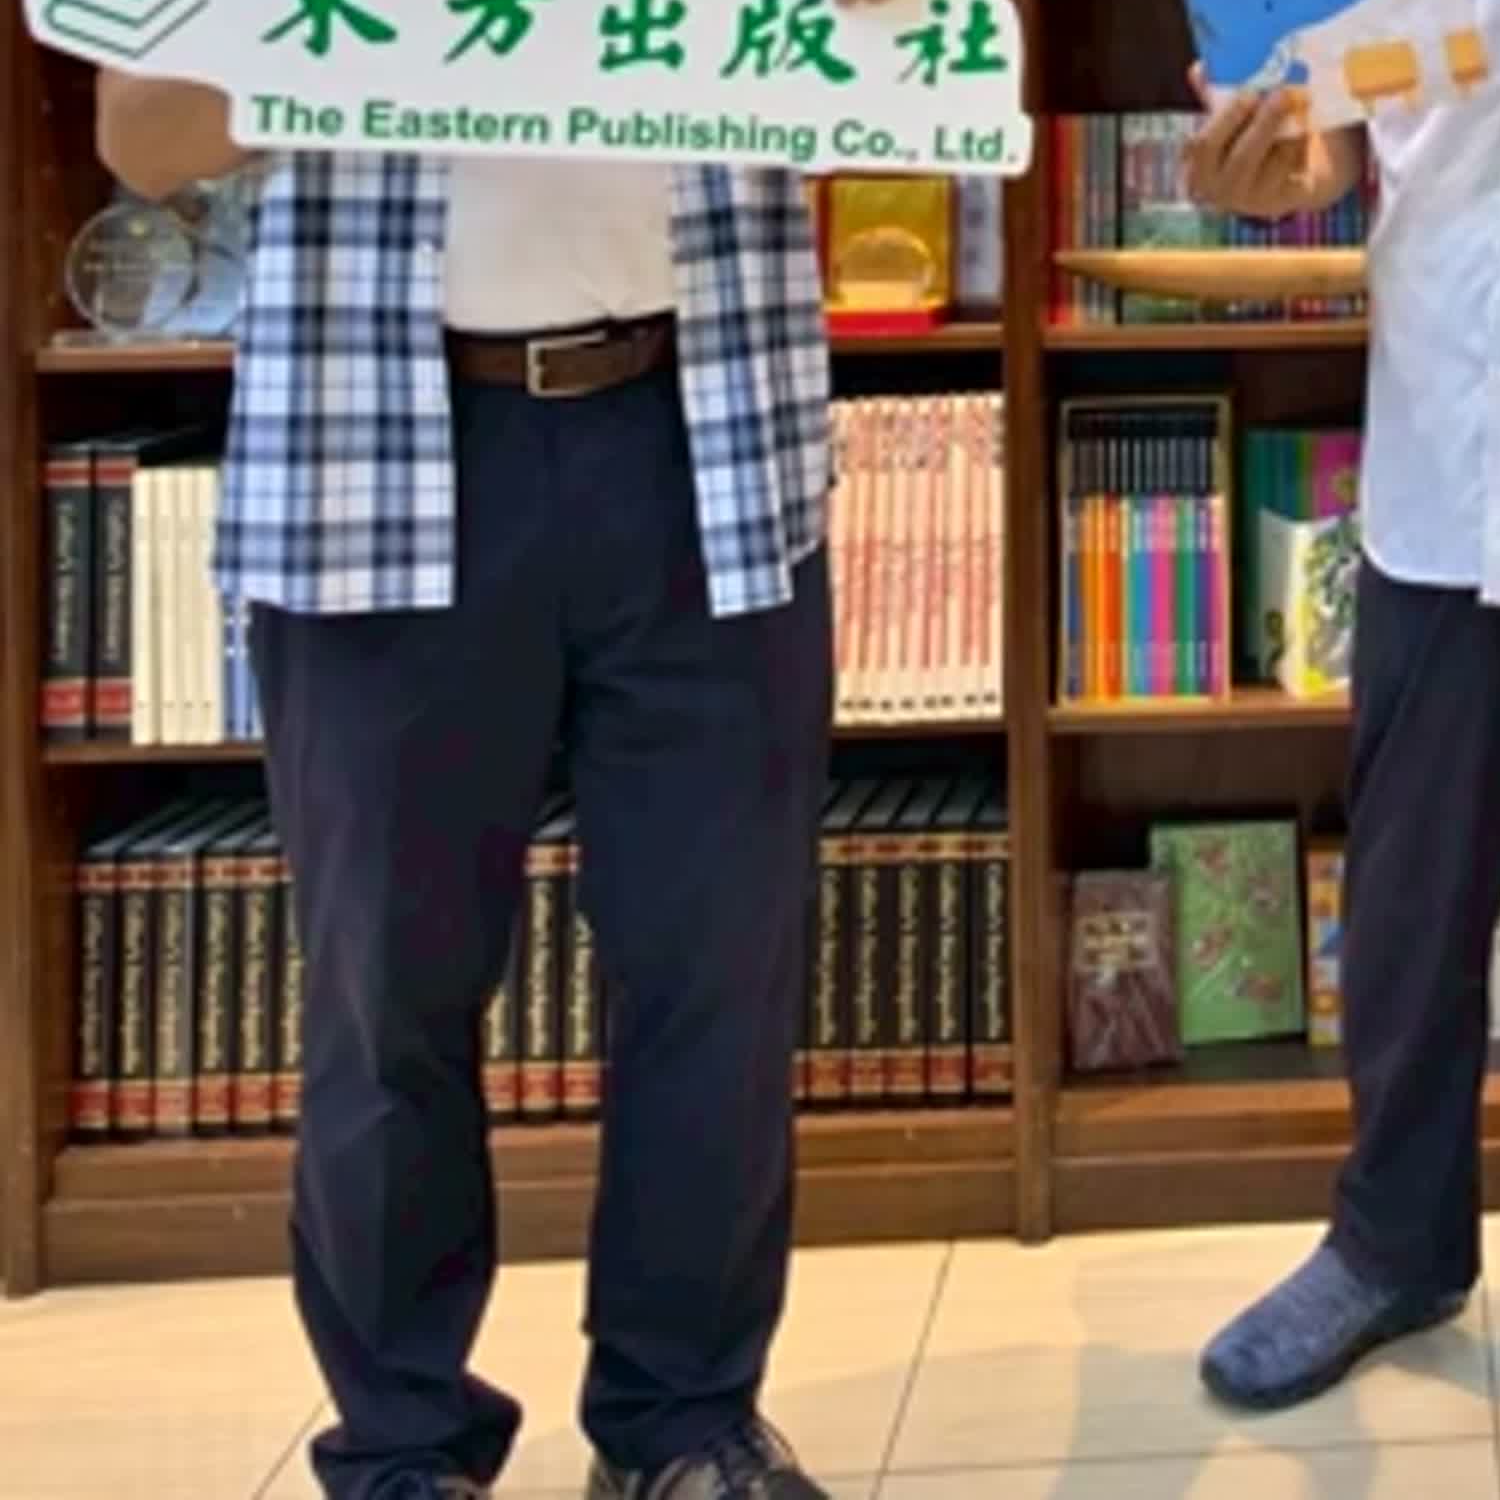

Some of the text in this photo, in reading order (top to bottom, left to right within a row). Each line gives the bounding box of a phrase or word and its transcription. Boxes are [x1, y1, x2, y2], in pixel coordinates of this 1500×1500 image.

[250, 94, 1020, 167] The Eastern Publishing Co., Ltd.
